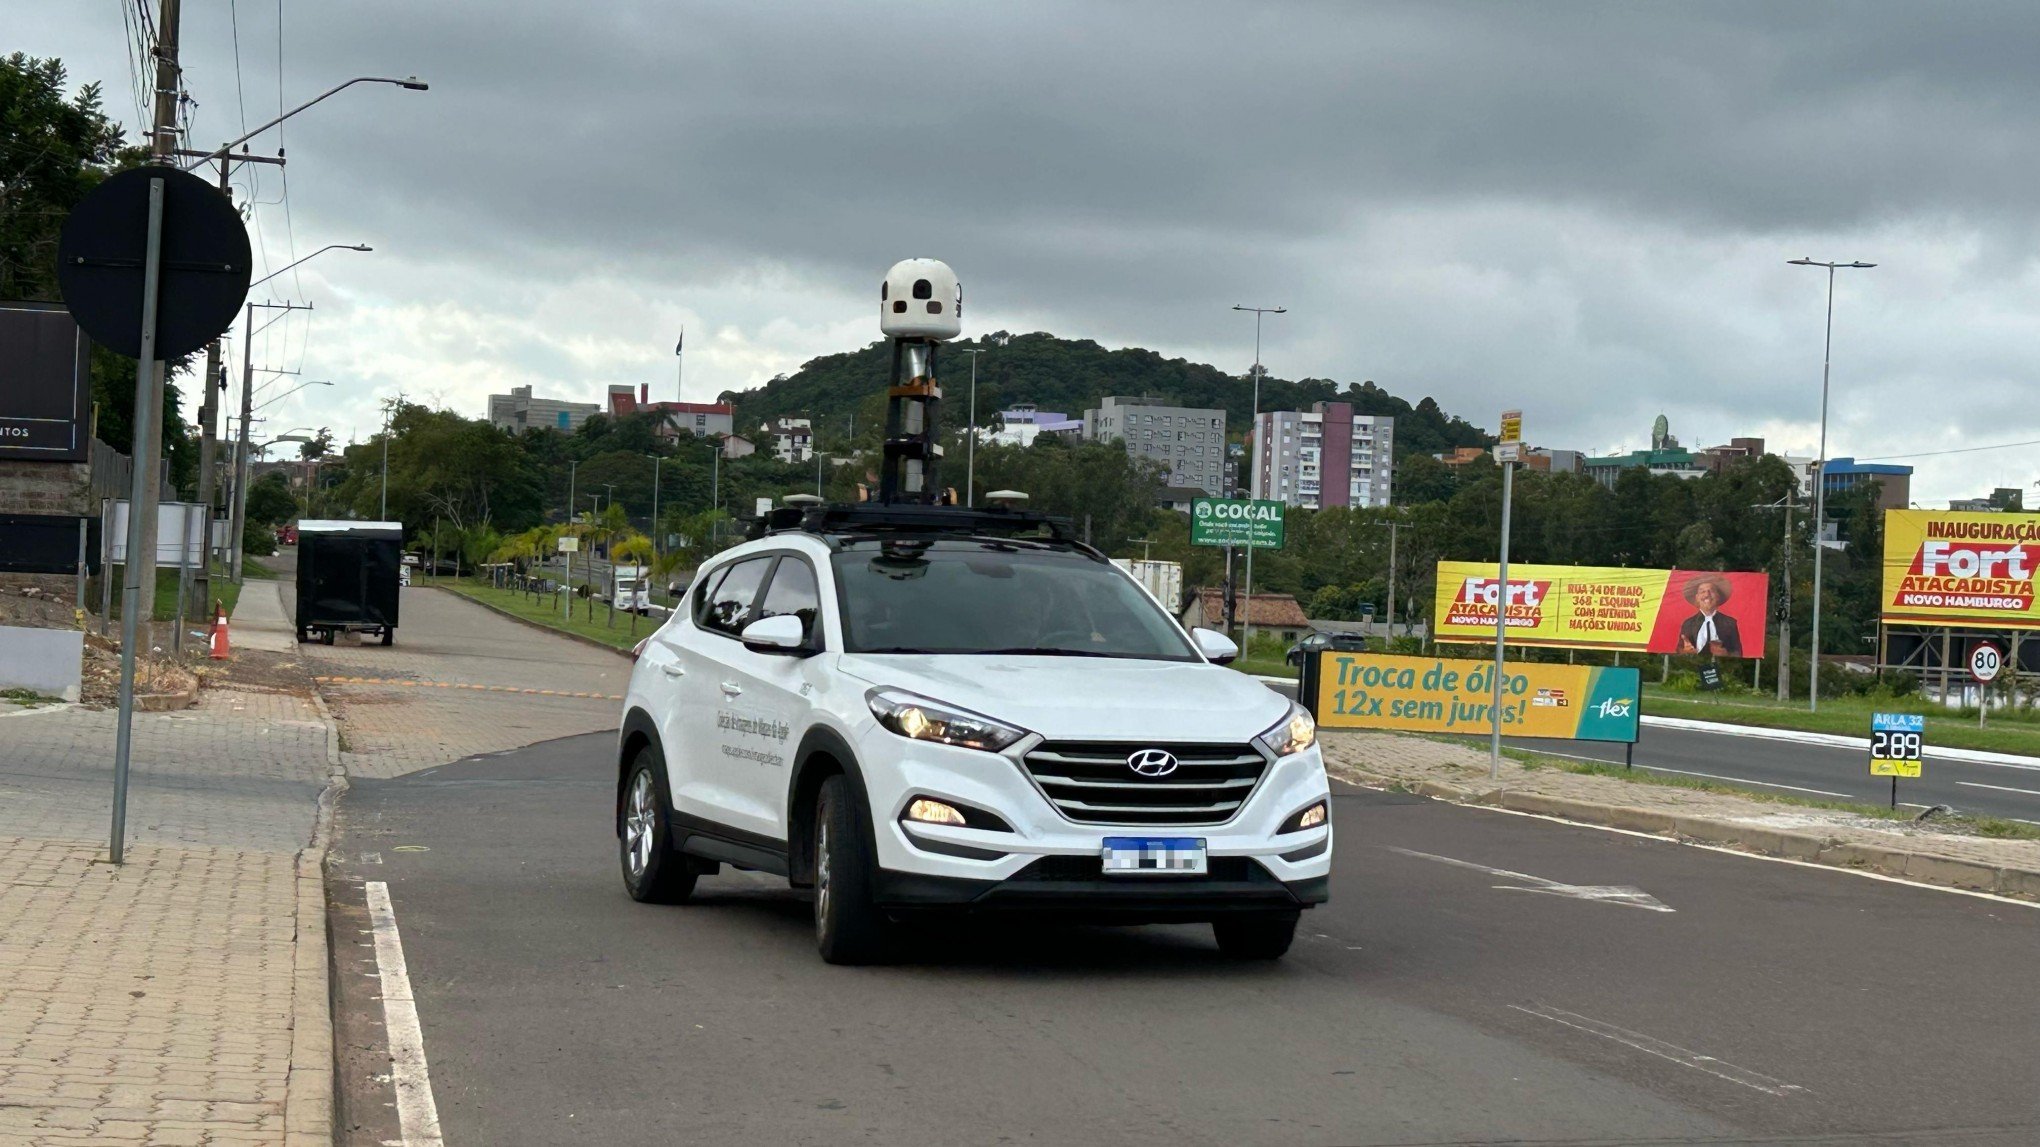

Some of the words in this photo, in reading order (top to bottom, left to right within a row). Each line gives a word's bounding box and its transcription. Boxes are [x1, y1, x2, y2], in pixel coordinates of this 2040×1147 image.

[1215, 503, 1282, 521] COCAL
[1923, 541, 2030, 580] Fort
[1466, 577, 1540, 606] Fort
[1568, 584, 1588, 594] RUA
[1590, 585, 1602, 595] 24
[1604, 586, 1616, 595] DE
[1901, 576, 2034, 595] ATACADISTA
[1573, 596, 1593, 606] 368
[1599, 596, 1640, 608] ESQUINA
[1904, 594, 1943, 605] NOVO
[1945, 596, 2023, 609] HAMBURGO
[1452, 616, 1479, 625] NOVO
[1575, 607, 1595, 618] COM
[1597, 608, 1637, 619] AVENIDA
[1569, 618, 1606, 631] NAÇÕES
[1607, 621, 1642, 632] UNIDAS
[1975, 652, 1997, 669] 80
[1336, 657, 1415, 690] Troca
[1422, 662, 1459, 692] de
[1333, 689, 1384, 716] 12x
[1390, 697, 1443, 720] sem
[1599, 697, 1630, 719] flex
[1873, 713, 1907, 726] ARLA
[1909, 715, 1923, 726] 32
